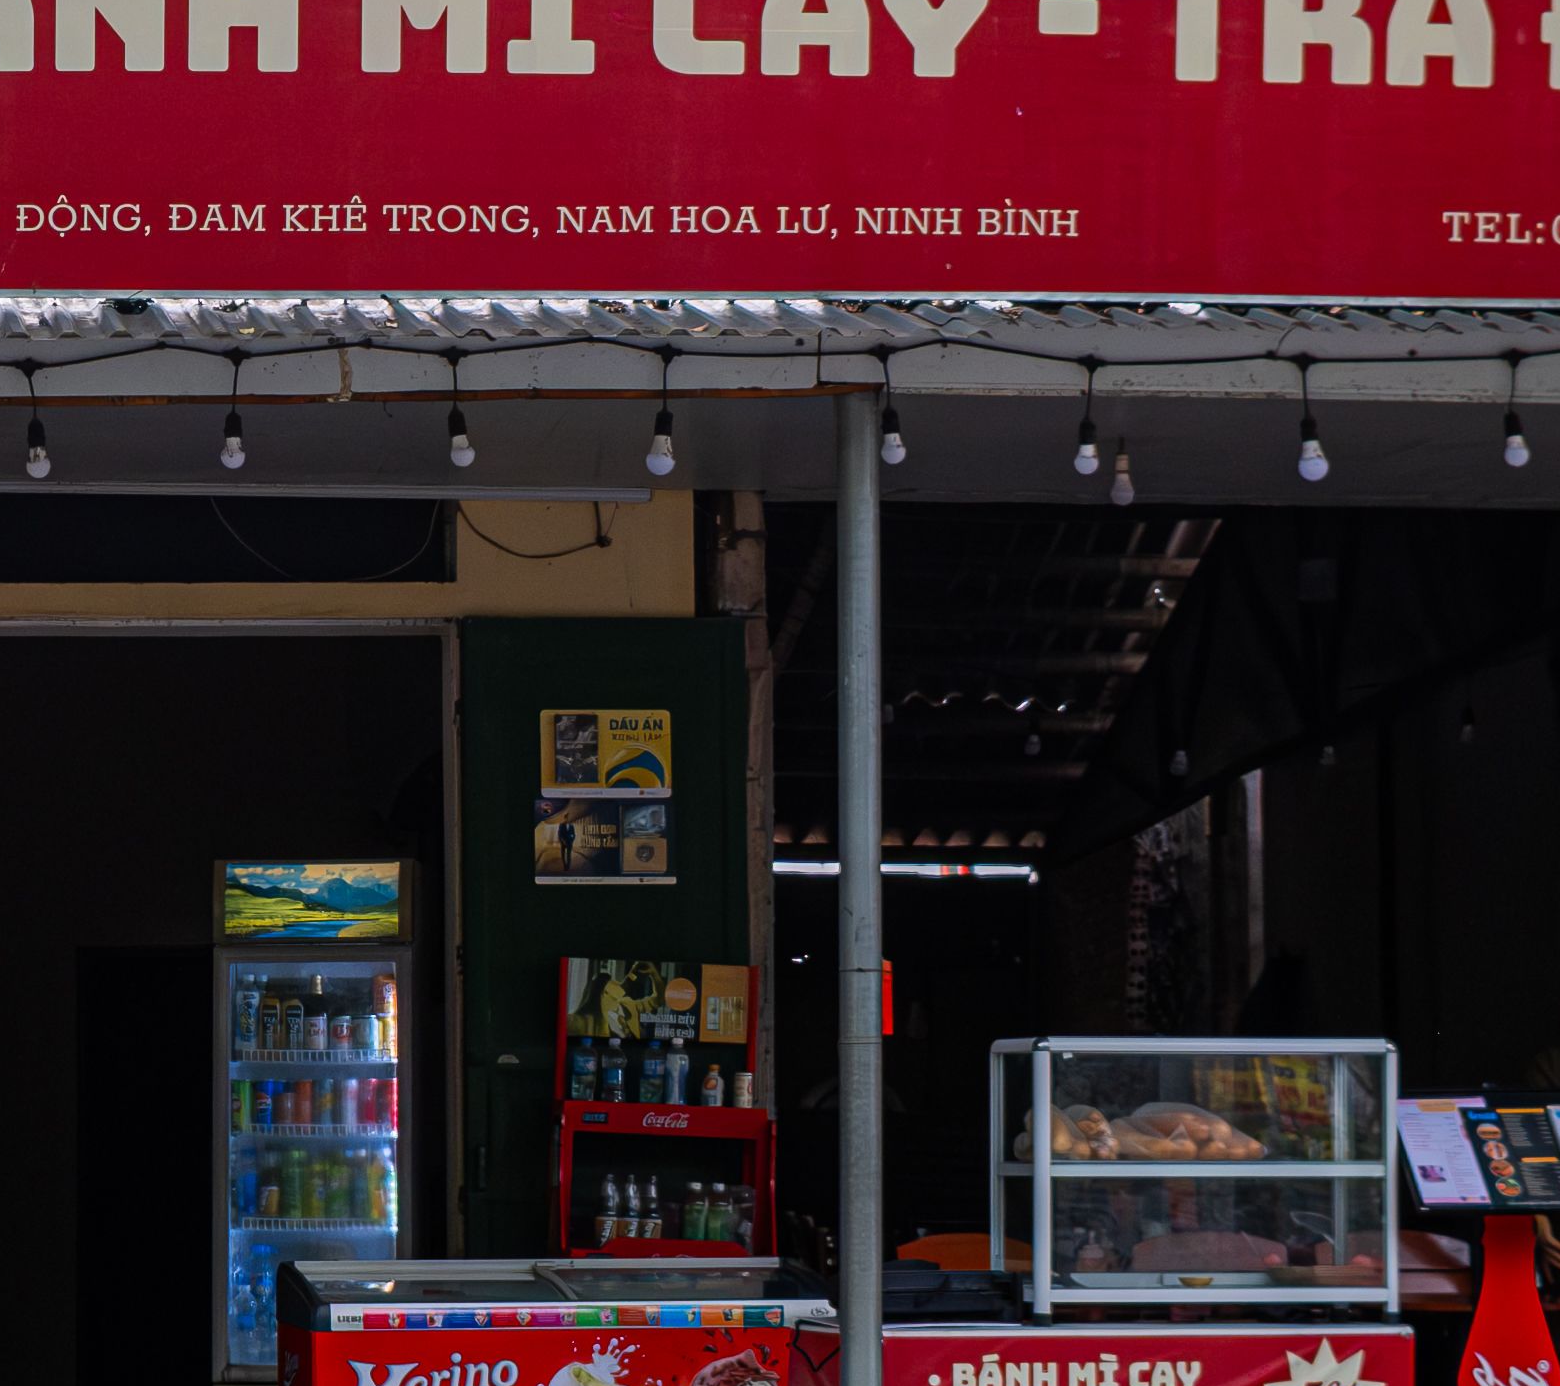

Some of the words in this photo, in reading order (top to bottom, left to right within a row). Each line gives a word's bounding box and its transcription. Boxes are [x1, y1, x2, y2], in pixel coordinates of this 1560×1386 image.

[15, 194, 151, 237] ĐỘNG,
[168, 203, 266, 232] ĐAM
[282, 195, 367, 232] KHÊ
[382, 204, 539, 238] TRONG,
[556, 205, 654, 234] NAM
[670, 205, 761, 234] HOA
[776, 203, 838, 240] LƯ,
[854, 207, 962, 235] NINH
[977, 198, 1079, 237] BÌNH
